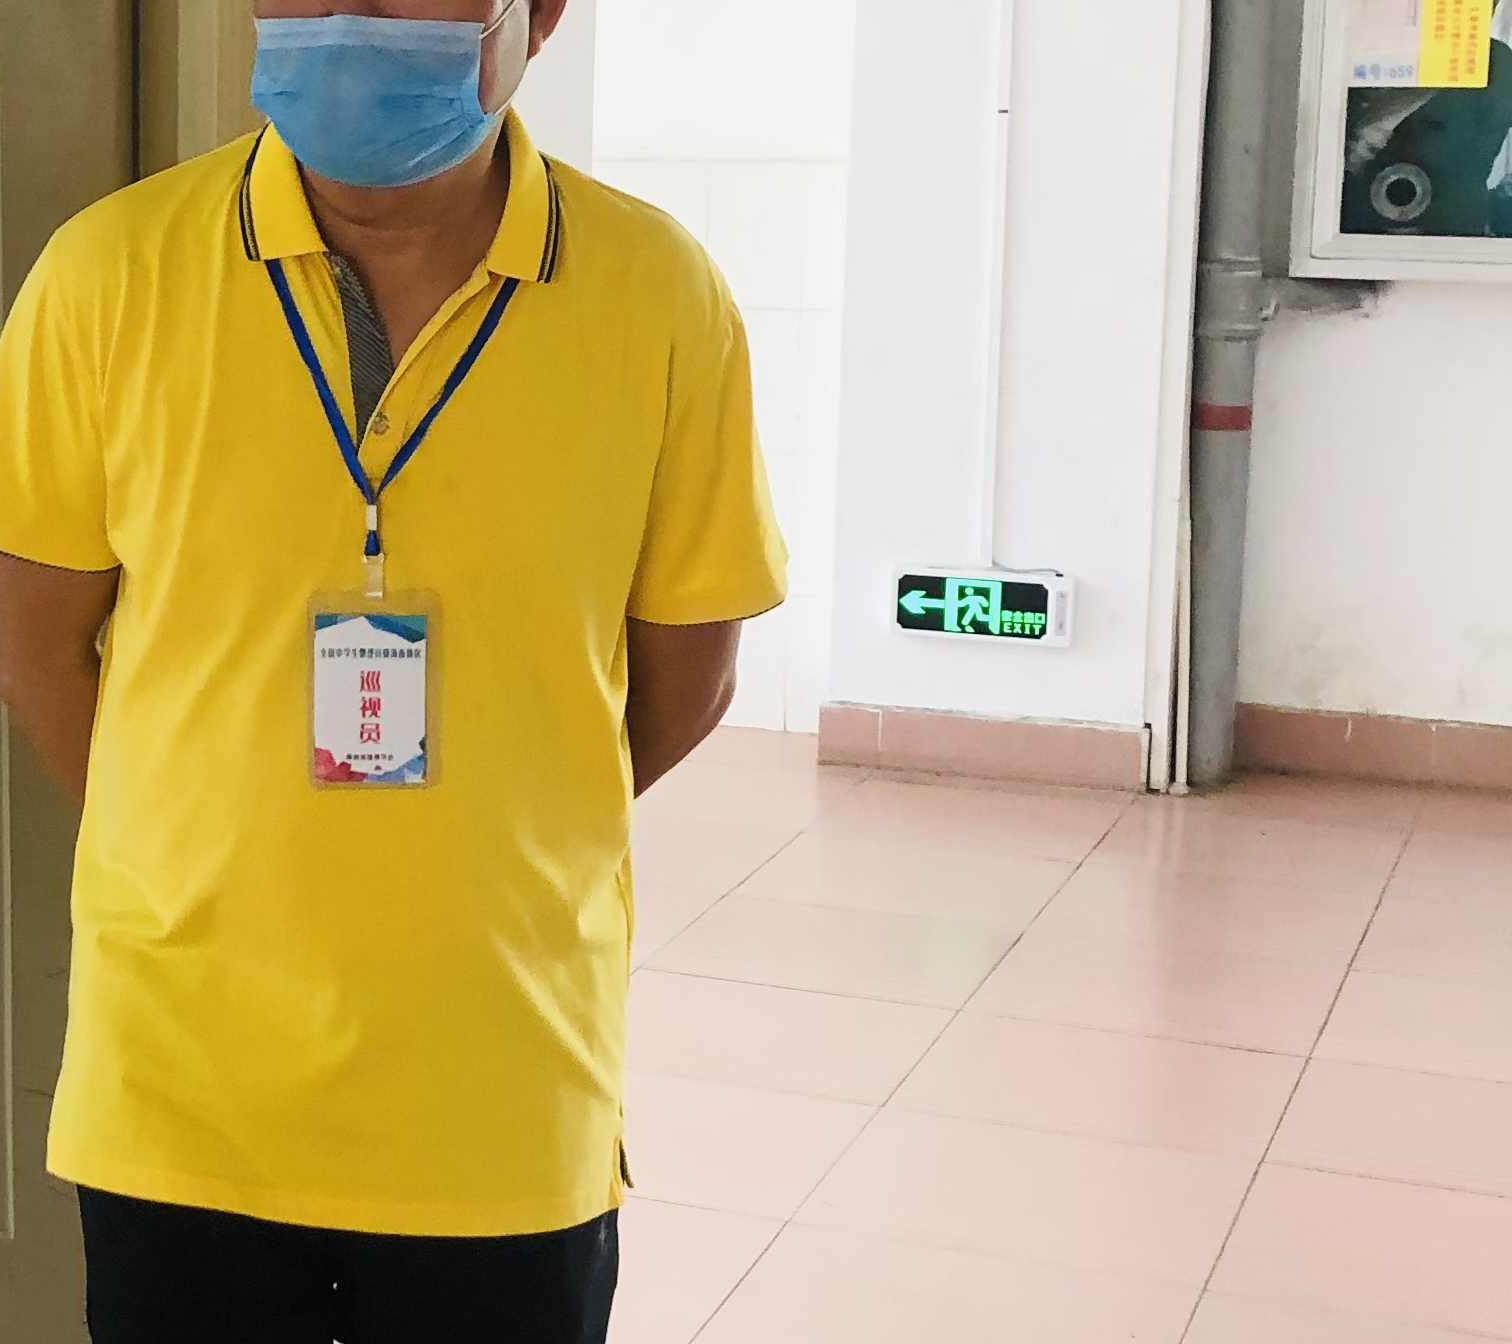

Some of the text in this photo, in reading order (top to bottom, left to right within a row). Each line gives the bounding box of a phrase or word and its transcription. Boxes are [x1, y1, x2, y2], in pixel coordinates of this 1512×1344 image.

[1003, 622, 1043, 635] EXIT
[359, 670, 382, 745] 巡视员
